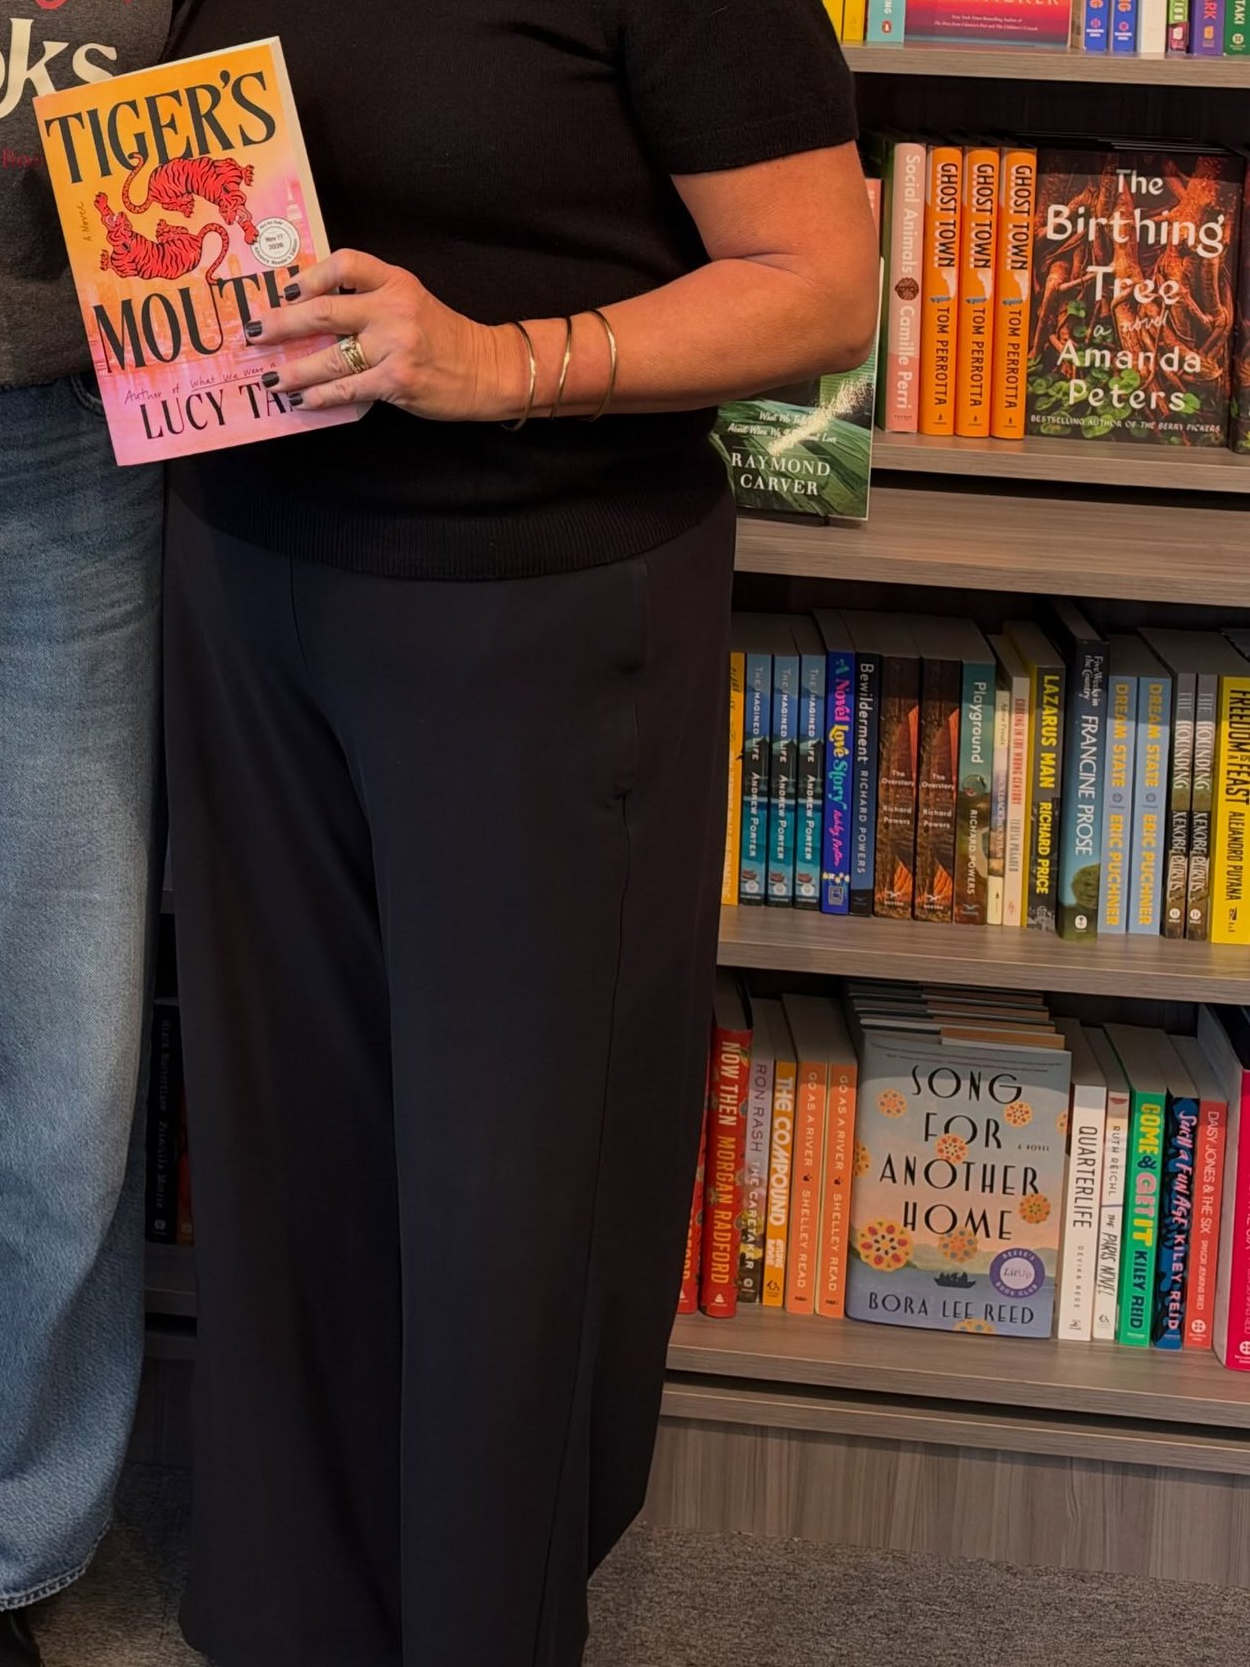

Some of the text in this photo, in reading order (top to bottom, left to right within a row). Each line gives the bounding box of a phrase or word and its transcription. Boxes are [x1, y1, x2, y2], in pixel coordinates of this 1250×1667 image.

[44, 69, 276, 184] TIGER'S
[1115, 169, 1164, 196] The
[1046, 205, 1226, 257] Birthing
[933, 163, 958, 407] GHOST TOWN TOM PERROTTA
[1086, 266, 1180, 305] Tree
[1093, 312, 1167, 338] a novel
[1056, 340, 1201, 374] Amanda
[125, 389, 161, 404] Author
[172, 386, 179, 394] of
[190, 377, 215, 388] What
[223, 374, 238, 384] We
[1069, 380, 1186, 412] Peters
[139, 382, 294, 439] LUCY TA
[1030, 414, 1221, 433] BESTSELLING AUTHOR OF THE BERRY PICKERS
[730, 453, 831, 478] RAYMOND
[740, 473, 819, 496] CARVER
[1036, 675, 1060, 896] LAZARUS MAN RICHARD PRICE
[1075, 714, 1099, 857] FRANCINE PROSE
[911, 1064, 1023, 1104] SONG
[923, 1111, 1003, 1150] FOR
[878, 1153, 1044, 1197] ANOTHER
[1072, 1125, 1098, 1229] QUARTERLIFE
[902, 1202, 1014, 1241] HOME
[995, 1281, 1038, 1296] BOOK CLUB
[868, 1292, 1035, 1325] BORA LEE REED
